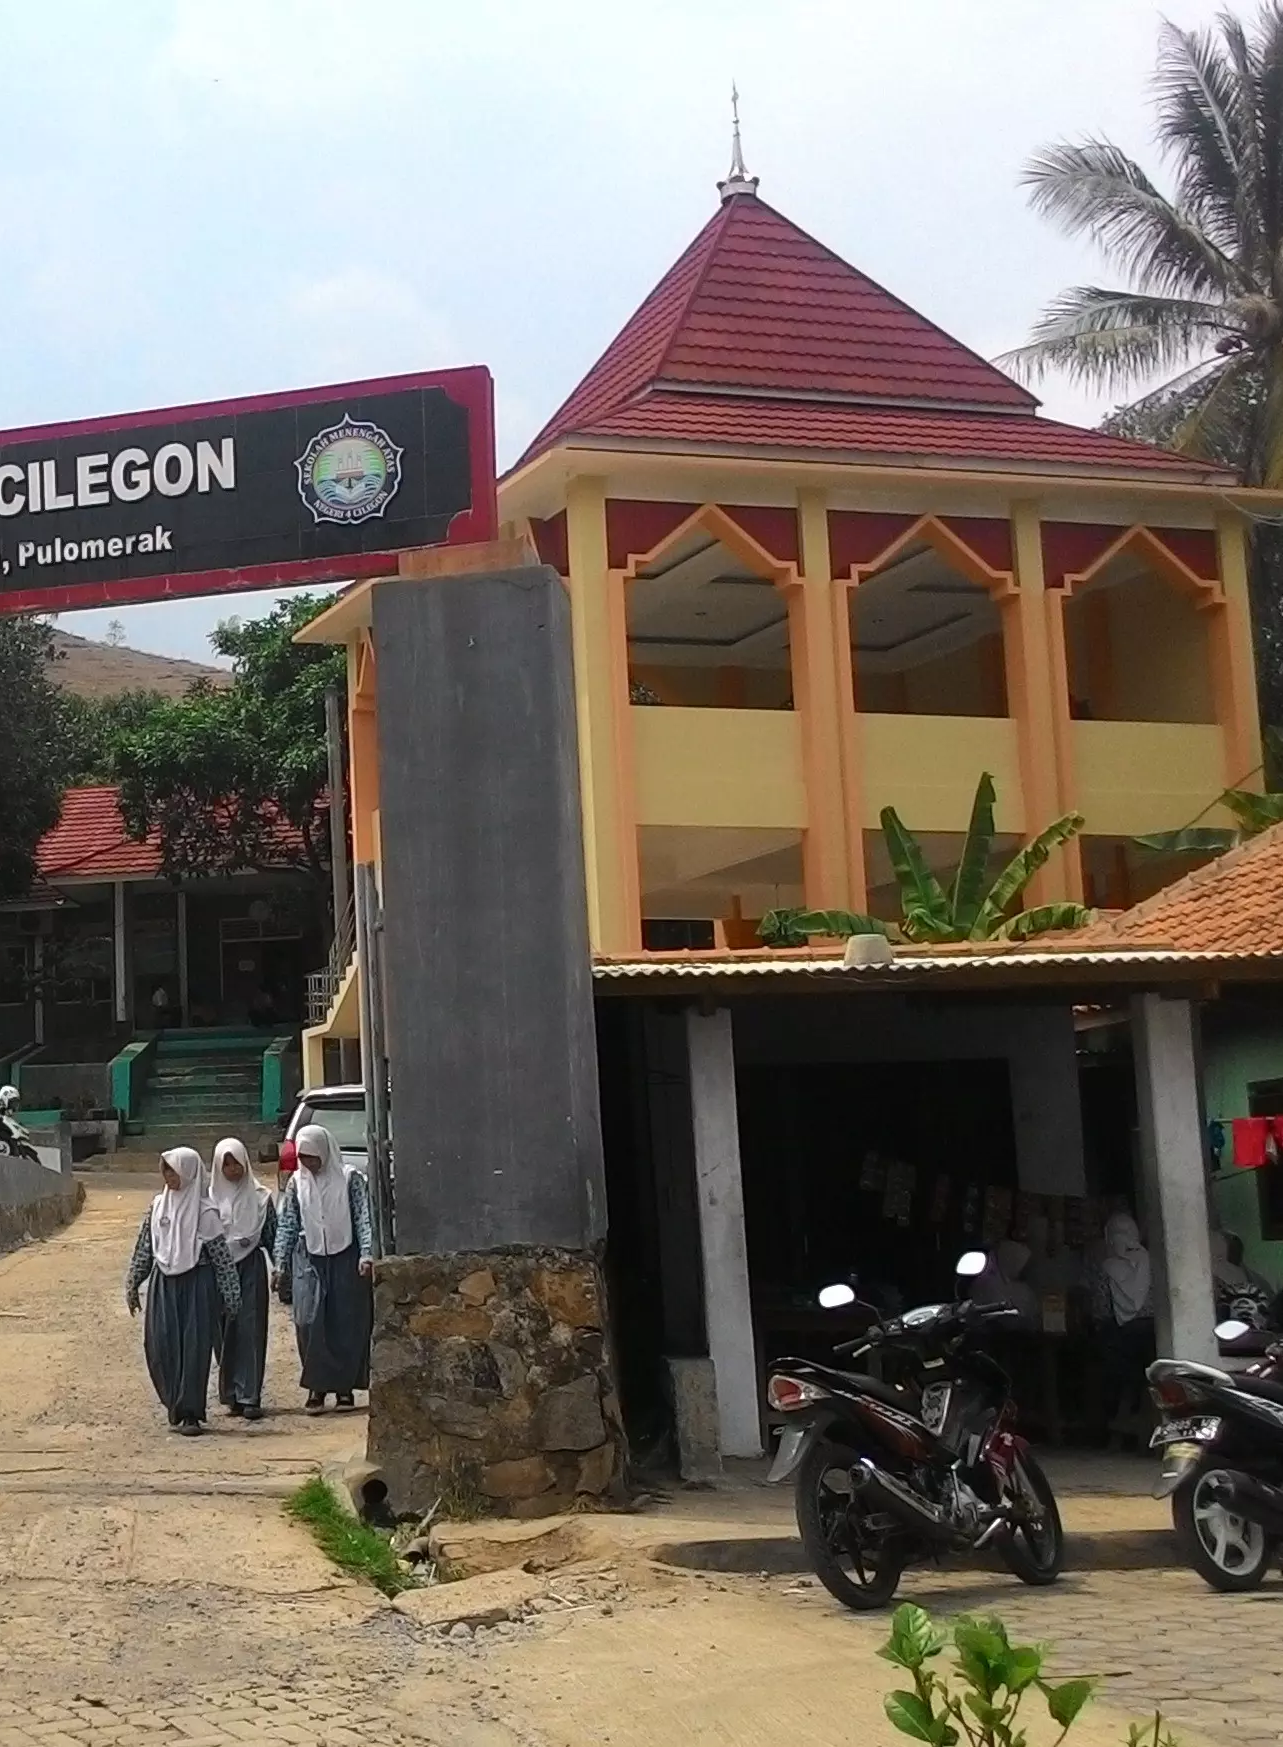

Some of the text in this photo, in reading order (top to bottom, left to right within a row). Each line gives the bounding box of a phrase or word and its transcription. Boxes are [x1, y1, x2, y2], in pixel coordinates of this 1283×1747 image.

[303, 427, 396, 485] SEKOLAH MENENGAH ATAS
[313, 499, 344, 519] NEGERI
[352, 491, 388, 517] CILEGON
[18, 525, 174, 568] Pulomerak
